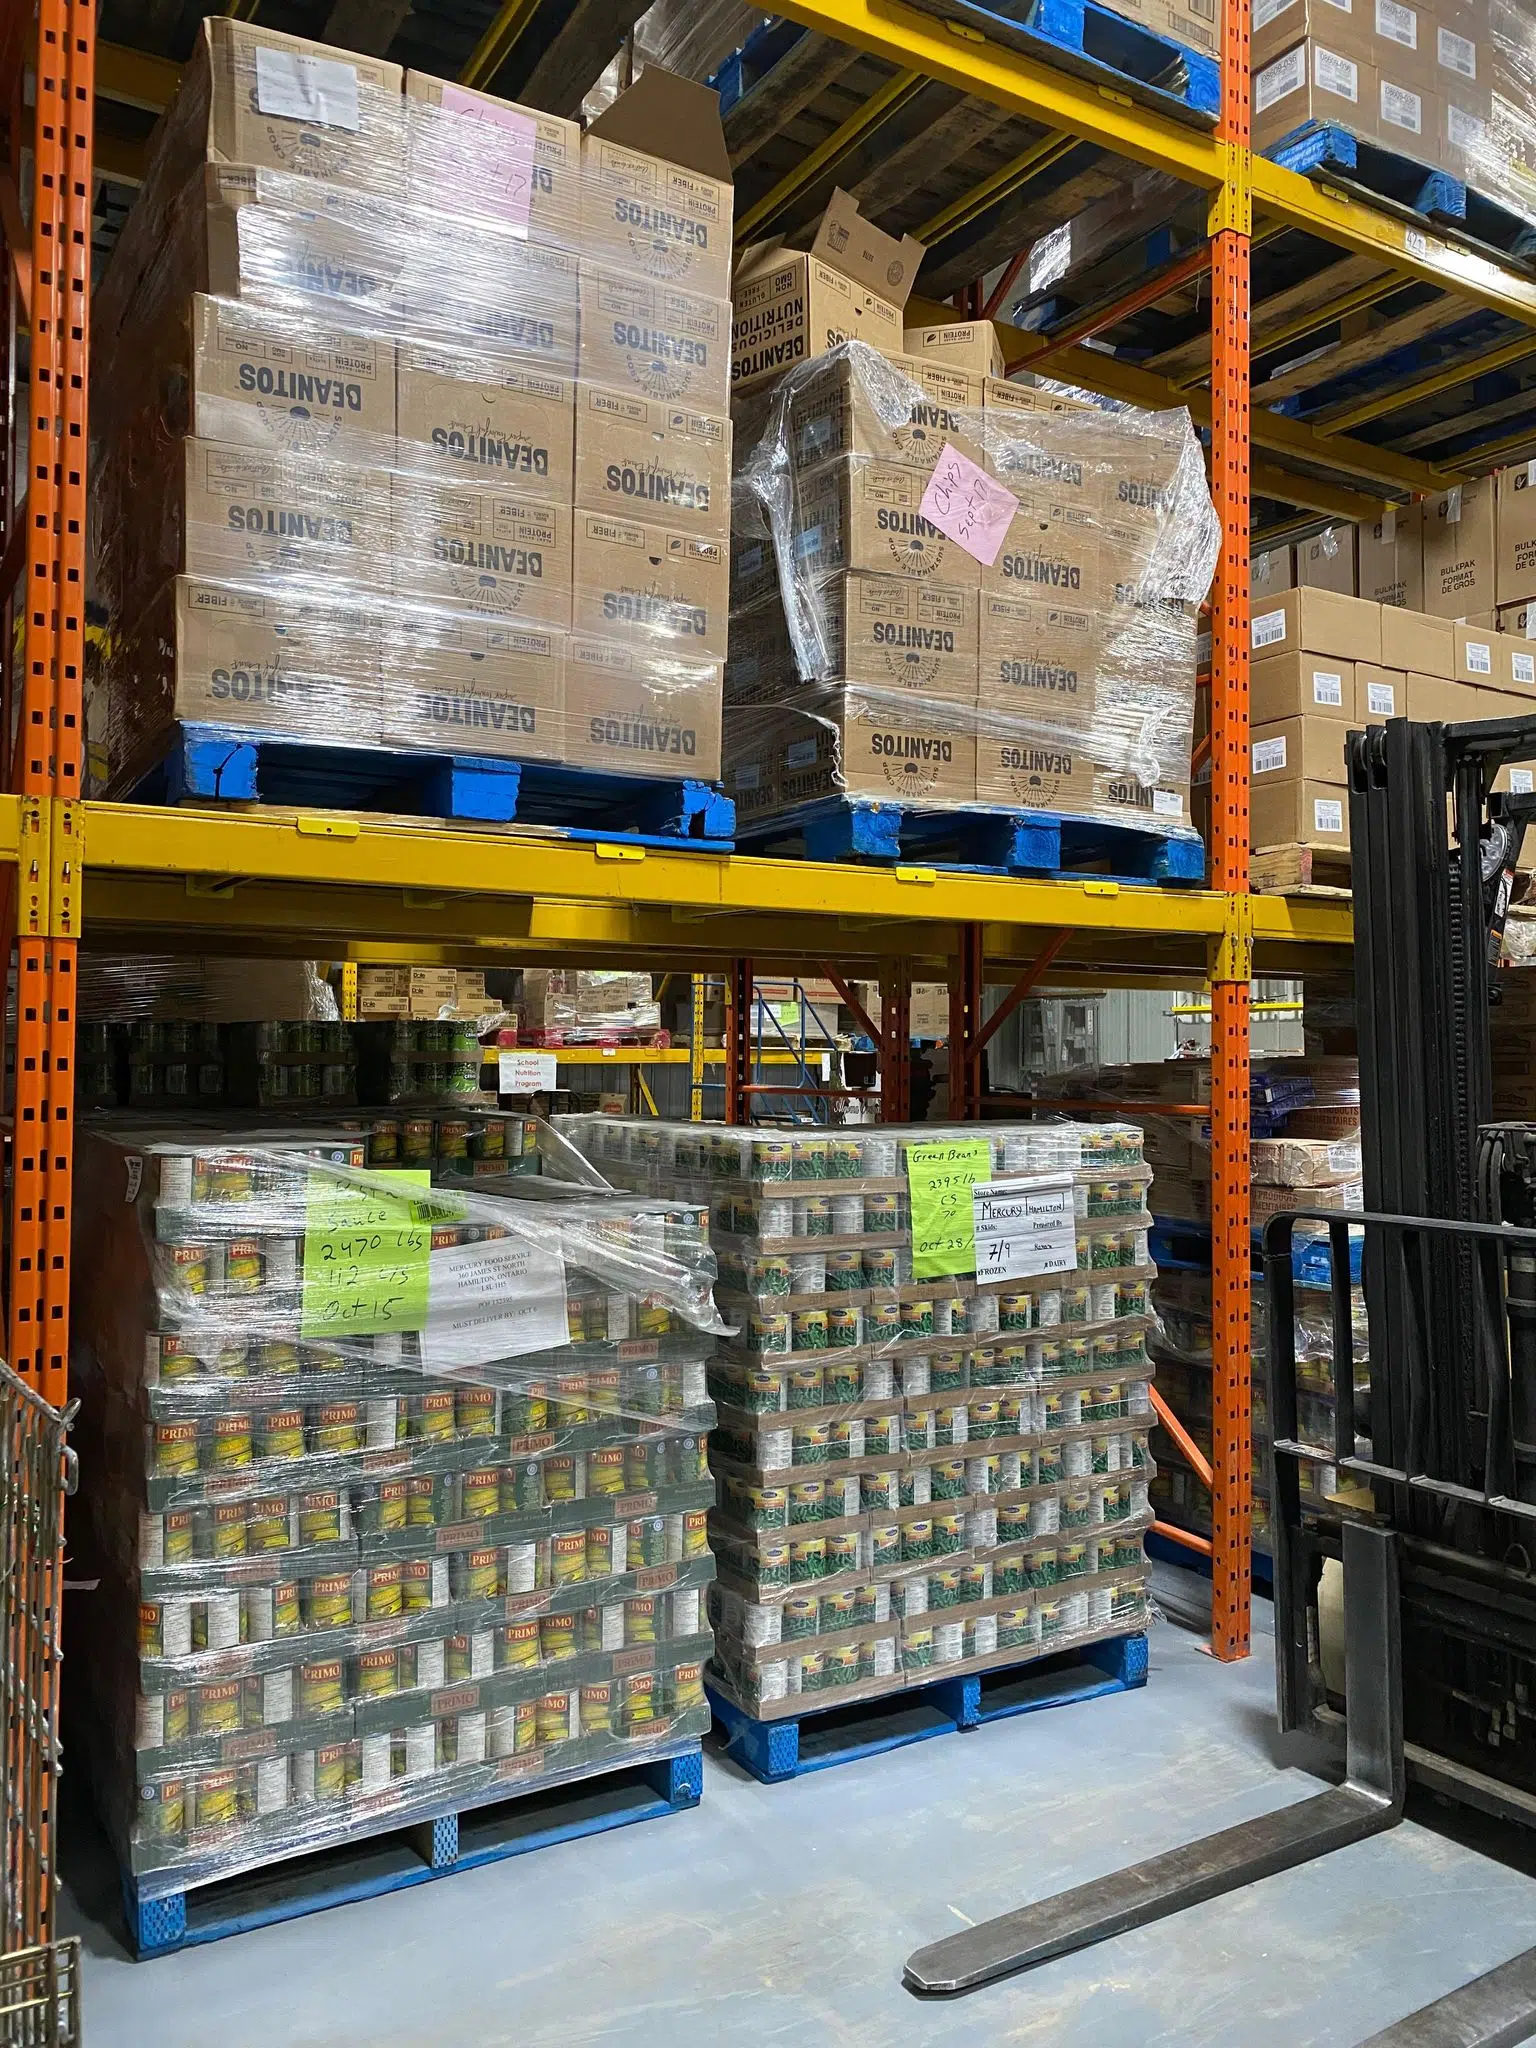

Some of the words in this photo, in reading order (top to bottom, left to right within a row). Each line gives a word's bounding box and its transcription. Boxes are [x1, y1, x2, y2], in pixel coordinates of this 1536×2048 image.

[672, 176, 694, 192] FIBER
[614, 197, 708, 250] BEANITOS
[775, 272, 793, 286] GMO
[818, 270, 834, 285] FIBER
[775, 280, 793, 293] NON
[738, 292, 765, 309] GLUTEN
[731, 315, 803, 353] DELICIOUS
[943, 330, 971, 339] PROTEIN
[612, 320, 708, 369] BEANITOS
[334, 356, 372, 370] PROTEIN
[731, 335, 804, 381] BEANITOS
[926, 372, 946, 383] FIBER
[239, 363, 362, 412] BEANITOS
[941, 389, 966, 401] PROTEIN
[996, 391, 1015, 402] FIBER
[596, 399, 619, 411] FIBER
[431, 427, 548, 476] BEANITOS
[606, 465, 709, 512] BEANITOS
[935, 462, 961, 515] Chips
[499, 506, 525, 518] FIBER
[958, 495, 977, 540] Sept
[973, 478, 988, 500] 17
[518, 526, 552, 539] PROTEIN
[593, 525, 616, 538] FIBER
[432, 537, 542, 578] BEANITOS
[689, 543, 718, 556] PROIN
[888, 537, 901, 562] CROP
[900, 546, 944, 577] SUSTAINABLE
[1440, 559, 1476, 577] BULKPAK
[1515, 561, 1526, 571] DE
[1003, 555, 1081, 590] BEANITOS
[1443, 570, 1474, 586] FORMAT
[1441, 585, 1452, 594] DE
[1453, 578, 1476, 592] GROS
[197, 593, 228, 606] FIBER
[922, 593, 942, 603] FIBER
[603, 592, 706, 636] BEITOS
[936, 610, 961, 619] PROTEIN
[513, 636, 547, 649] PROTEIN
[873, 621, 954, 653] BEANITOS
[884, 650, 896, 676] CROP
[1000, 660, 1078, 693] BEANITOS
[415, 695, 536, 733] BEANITO
[590, 718, 696, 756] BEANITOS
[871, 733, 952, 762] BEANITOS
[1001, 748, 1072, 776] BEANITOS
[882, 761, 895, 786] CROP
[895, 767, 939, 798] SUSTAINABLE
[912, 1149, 945, 1163] Green
[947, 1149, 978, 1161] Beans
[928, 1175, 960, 1191] 2395
[973, 1189, 990, 1197] Store
[1029, 1203, 1062, 1214] HAMILTON
[320, 1235, 381, 1261] 2470
[397, 1231, 423, 1252] lbs
[432, 1233, 458, 1246] PRIM
[989, 1239, 1011, 1262] 7/9
[449, 1260, 482, 1273] MERCURY
[484, 1256, 503, 1265] FOOD
[503, 1250, 531, 1262] SERVICE
[1048, 1259, 1067, 1268] DAIRY
[329, 1265, 359, 1288] 112
[458, 1271, 470, 1280] 360
[470, 1268, 491, 1278] JAMES
[501, 1261, 526, 1271] NORTH
[497, 1269, 528, 1280] ONTARIO
[322, 1297, 368, 1321] Oct
[373, 1296, 405, 1321] 15
[452, 1319, 472, 1330] MUST
[473, 1313, 503, 1326] DELIVER
[518, 1307, 533, 1316] OCT
[425, 1396, 454, 1408] PRIM
[459, 1390, 491, 1403] RIMO
[321, 1408, 358, 1421] PRIMO
[373, 1571, 401, 1584] PRIM
[360, 1652, 396, 1667] PRIMO
[304, 1665, 340, 1680] PRIMO
[203, 1684, 240, 1699] PRIMO
[436, 1694, 475, 1710] PRIMO
